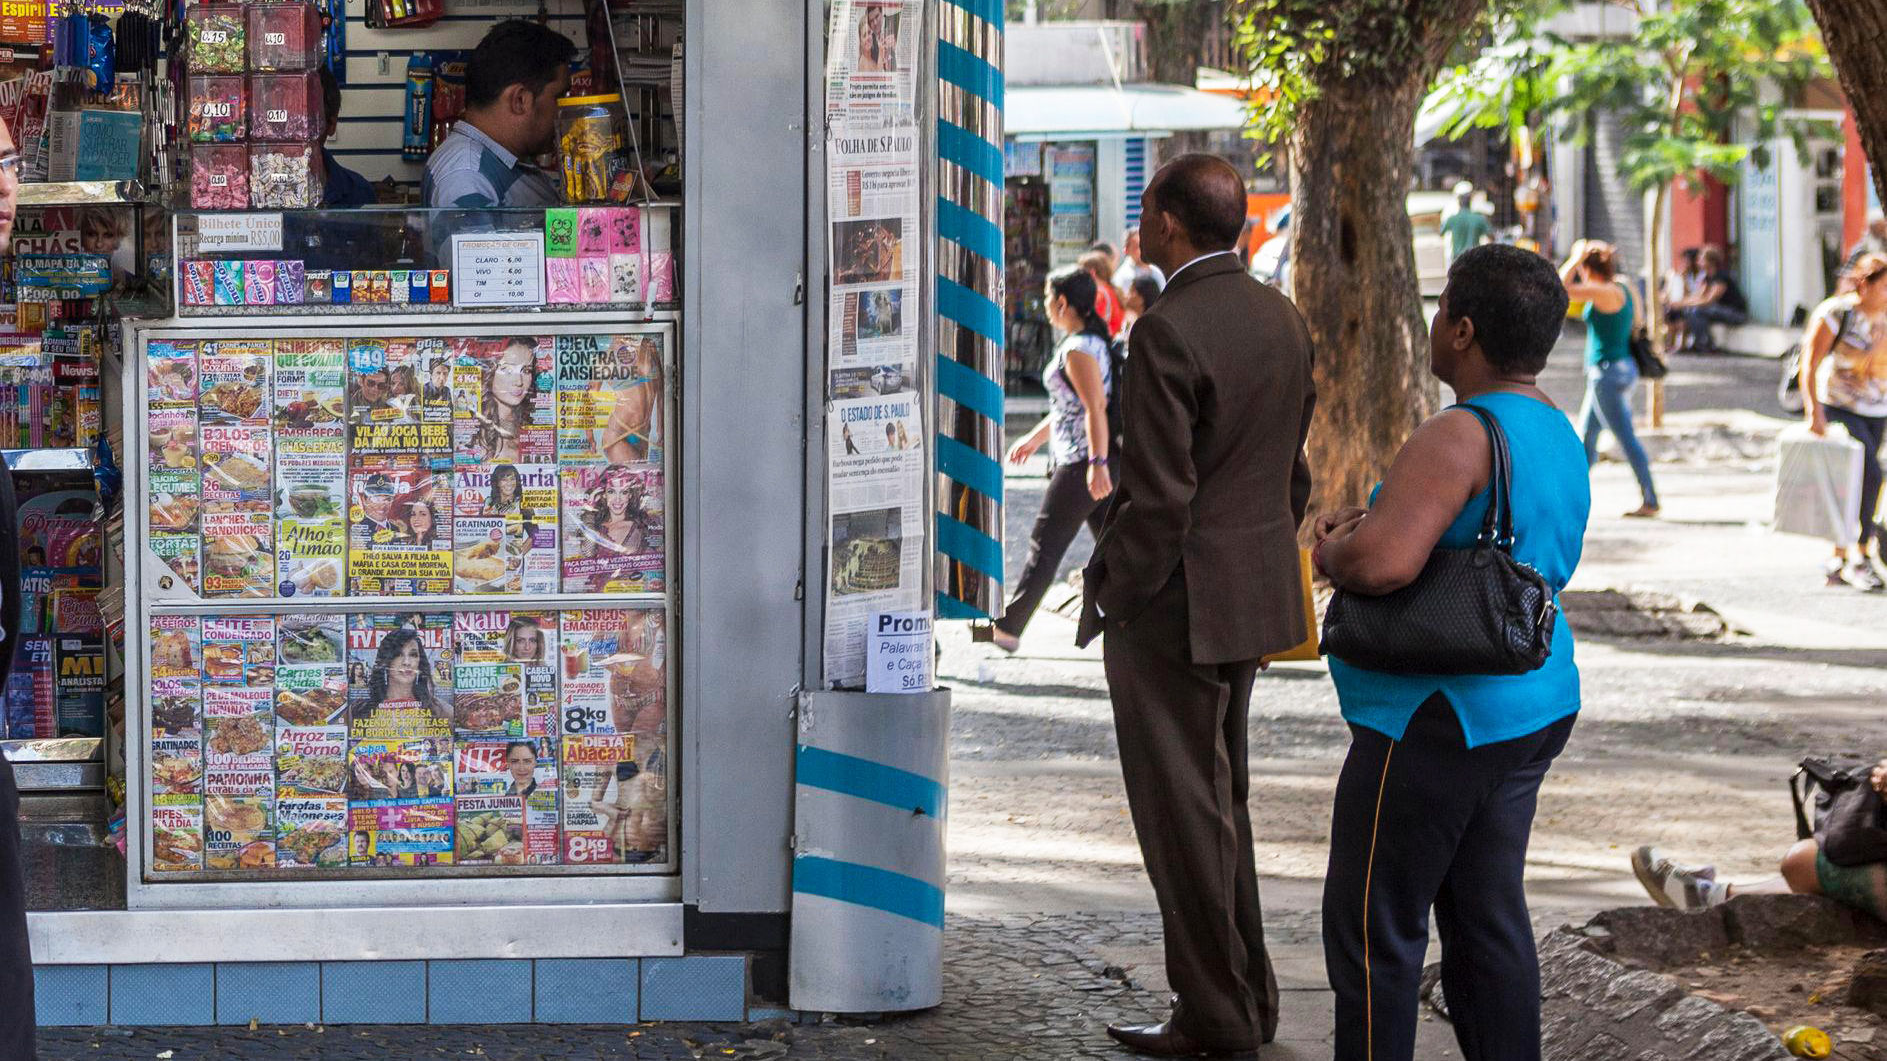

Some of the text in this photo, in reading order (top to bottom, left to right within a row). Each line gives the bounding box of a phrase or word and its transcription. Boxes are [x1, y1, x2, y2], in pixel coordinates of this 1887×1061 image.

[835, 138, 865, 154] FOLHA
[867, 138, 878, 153] DE
[199, 215, 281, 228] Bilhete Único
[200, 231, 280, 246] Recarga mínima R$5,00
[188, 263, 206, 303] mentos
[214, 261, 242, 305] mentos
[248, 263, 265, 303] mentos
[278, 262, 295, 303] mentos
[559, 337, 598, 350] DIETA
[559, 352, 617, 366] CONTRA
[559, 366, 639, 380] ANSIEDADE
[841, 402, 910, 422] O ESTADO DE S. PAULO
[204, 429, 250, 440] BOLOS
[204, 480, 219, 491] 26
[204, 491, 240, 499] RECEITAS
[204, 515, 245, 524] LANCHES
[286, 526, 324, 541] Alho
[292, 541, 343, 555] Limão
[206, 577, 221, 589] 93
[582, 610, 626, 621] SUCOS
[204, 619, 251, 630] LEITE
[454, 613, 510, 631] Malu
[564, 622, 628, 631] EMAGRECEM
[204, 631, 271, 639] CONDENSADO
[349, 630, 373, 648] TV
[880, 642, 924, 654] Palavras
[526, 667, 555, 675] CABELO
[887, 658, 921, 672] e Caça
[277, 667, 321, 678] Carnes
[456, 667, 497, 678] CARNE
[457, 677, 498, 688] MOÍDA
[902, 674, 914, 686] Só
[564, 707, 606, 733] 8 kg
[280, 729, 324, 742] Arroz
[583, 737, 625, 748] DIETA
[294, 743, 340, 755] Forno
[567, 747, 631, 761] Abacaxi
[207, 774, 271, 785] PAMONHA
[278, 800, 321, 810] Farofas
[458, 800, 485, 810] FESTA
[488, 799, 522, 808] JUNINA
[278, 810, 345, 821] Maioneses
[208, 830, 231, 840] 100
[570, 837, 587, 862] 8
[588, 839, 607, 854] kg
